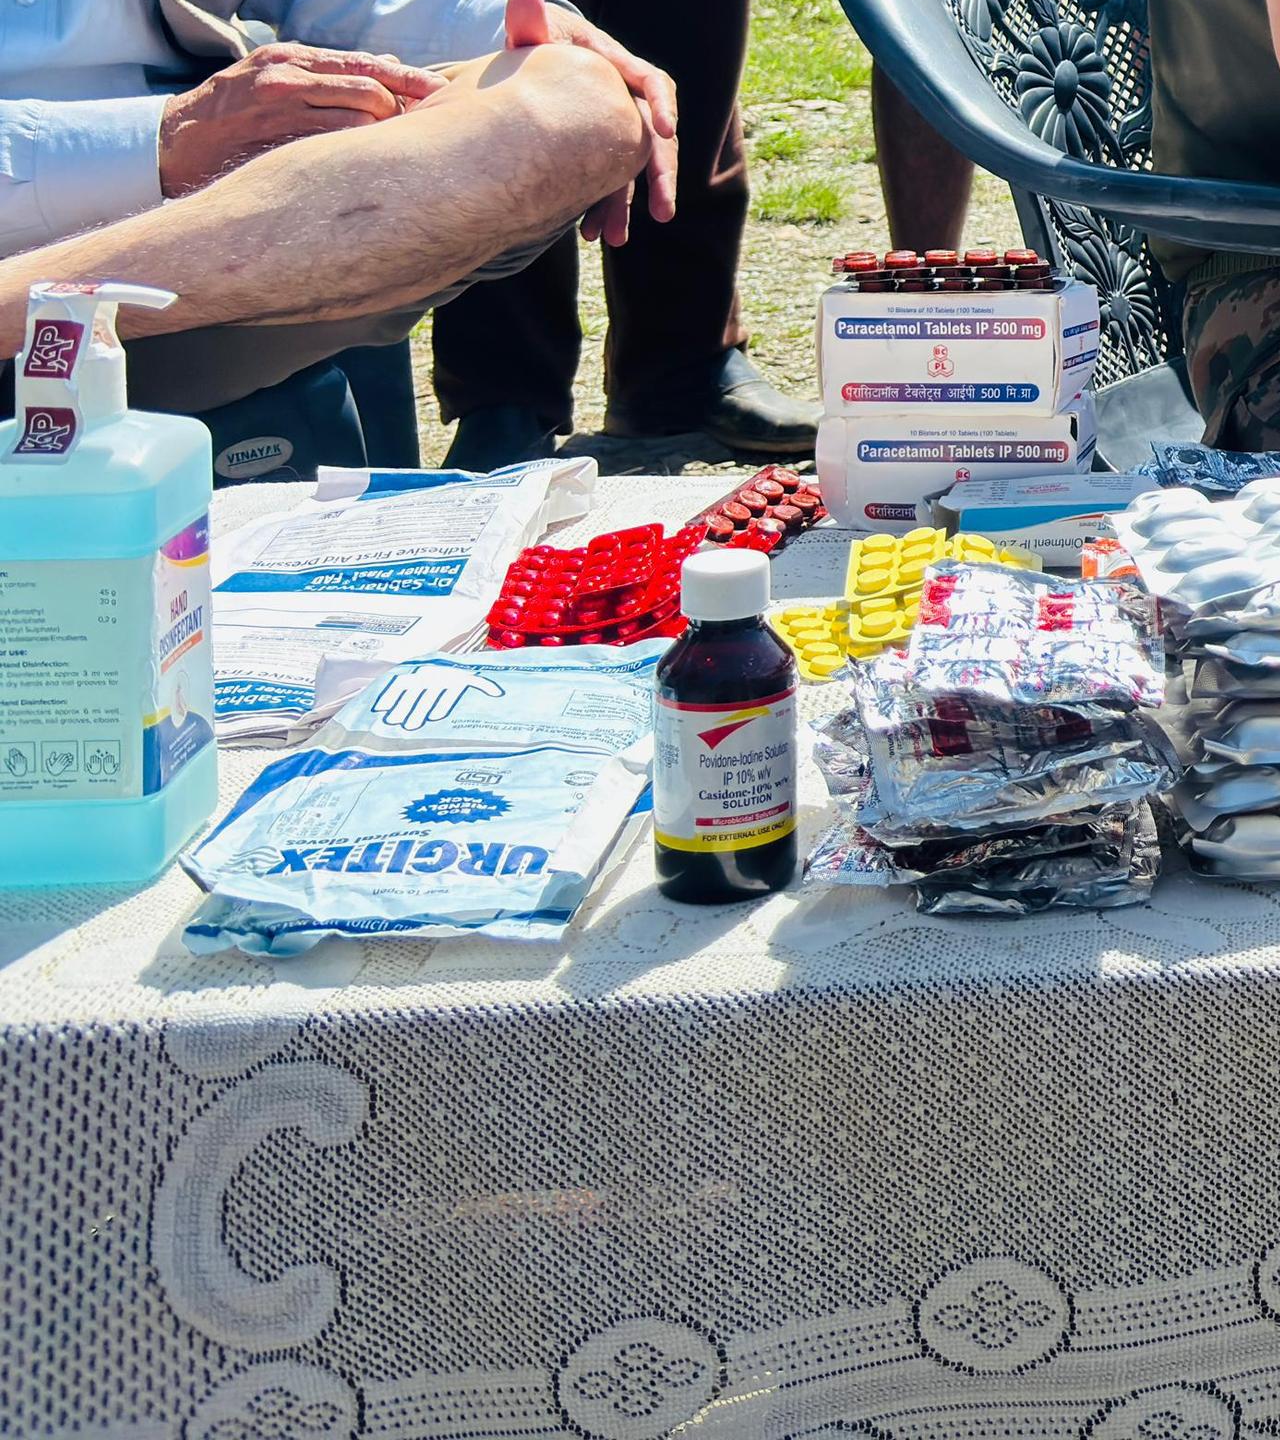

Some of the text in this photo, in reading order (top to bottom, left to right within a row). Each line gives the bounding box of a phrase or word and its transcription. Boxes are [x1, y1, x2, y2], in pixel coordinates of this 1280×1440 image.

[838, 321, 1042, 338] Paracetamol Tablets IP 500 mg
[934, 362, 947, 370] PL
[947, 384, 975, 400] आईपी
[981, 388, 1000, 399] 500
[226, 443, 282, 465] VINAYAK
[860, 445, 1065, 461] Paracetamol Tablets IP 500 mg
[1034, 537, 1083, 549] Ointment
[324, 556, 352, 564] Aid
[358, 550, 392, 561] First
[397, 546, 472, 558] Adhesive
[398, 565, 461, 577] Panther
[428, 577, 454, 587] Dr
[170, 590, 188, 623] HAND
[700, 749, 763, 769] Povidone-Iodine
[765, 741, 789, 758] Solution
[723, 766, 772, 786] IP 10% w/v
[699, 783, 772, 801] Casidone-10%
[416, 802, 497, 812] FRIENDLY
[722, 793, 772, 810] SOLUTION
[712, 814, 755, 826] Microbicidal
[285, 829, 433, 848] Surgical Gloves
[702, 820, 786, 842] FOR EXTERNAL USE ONLY
